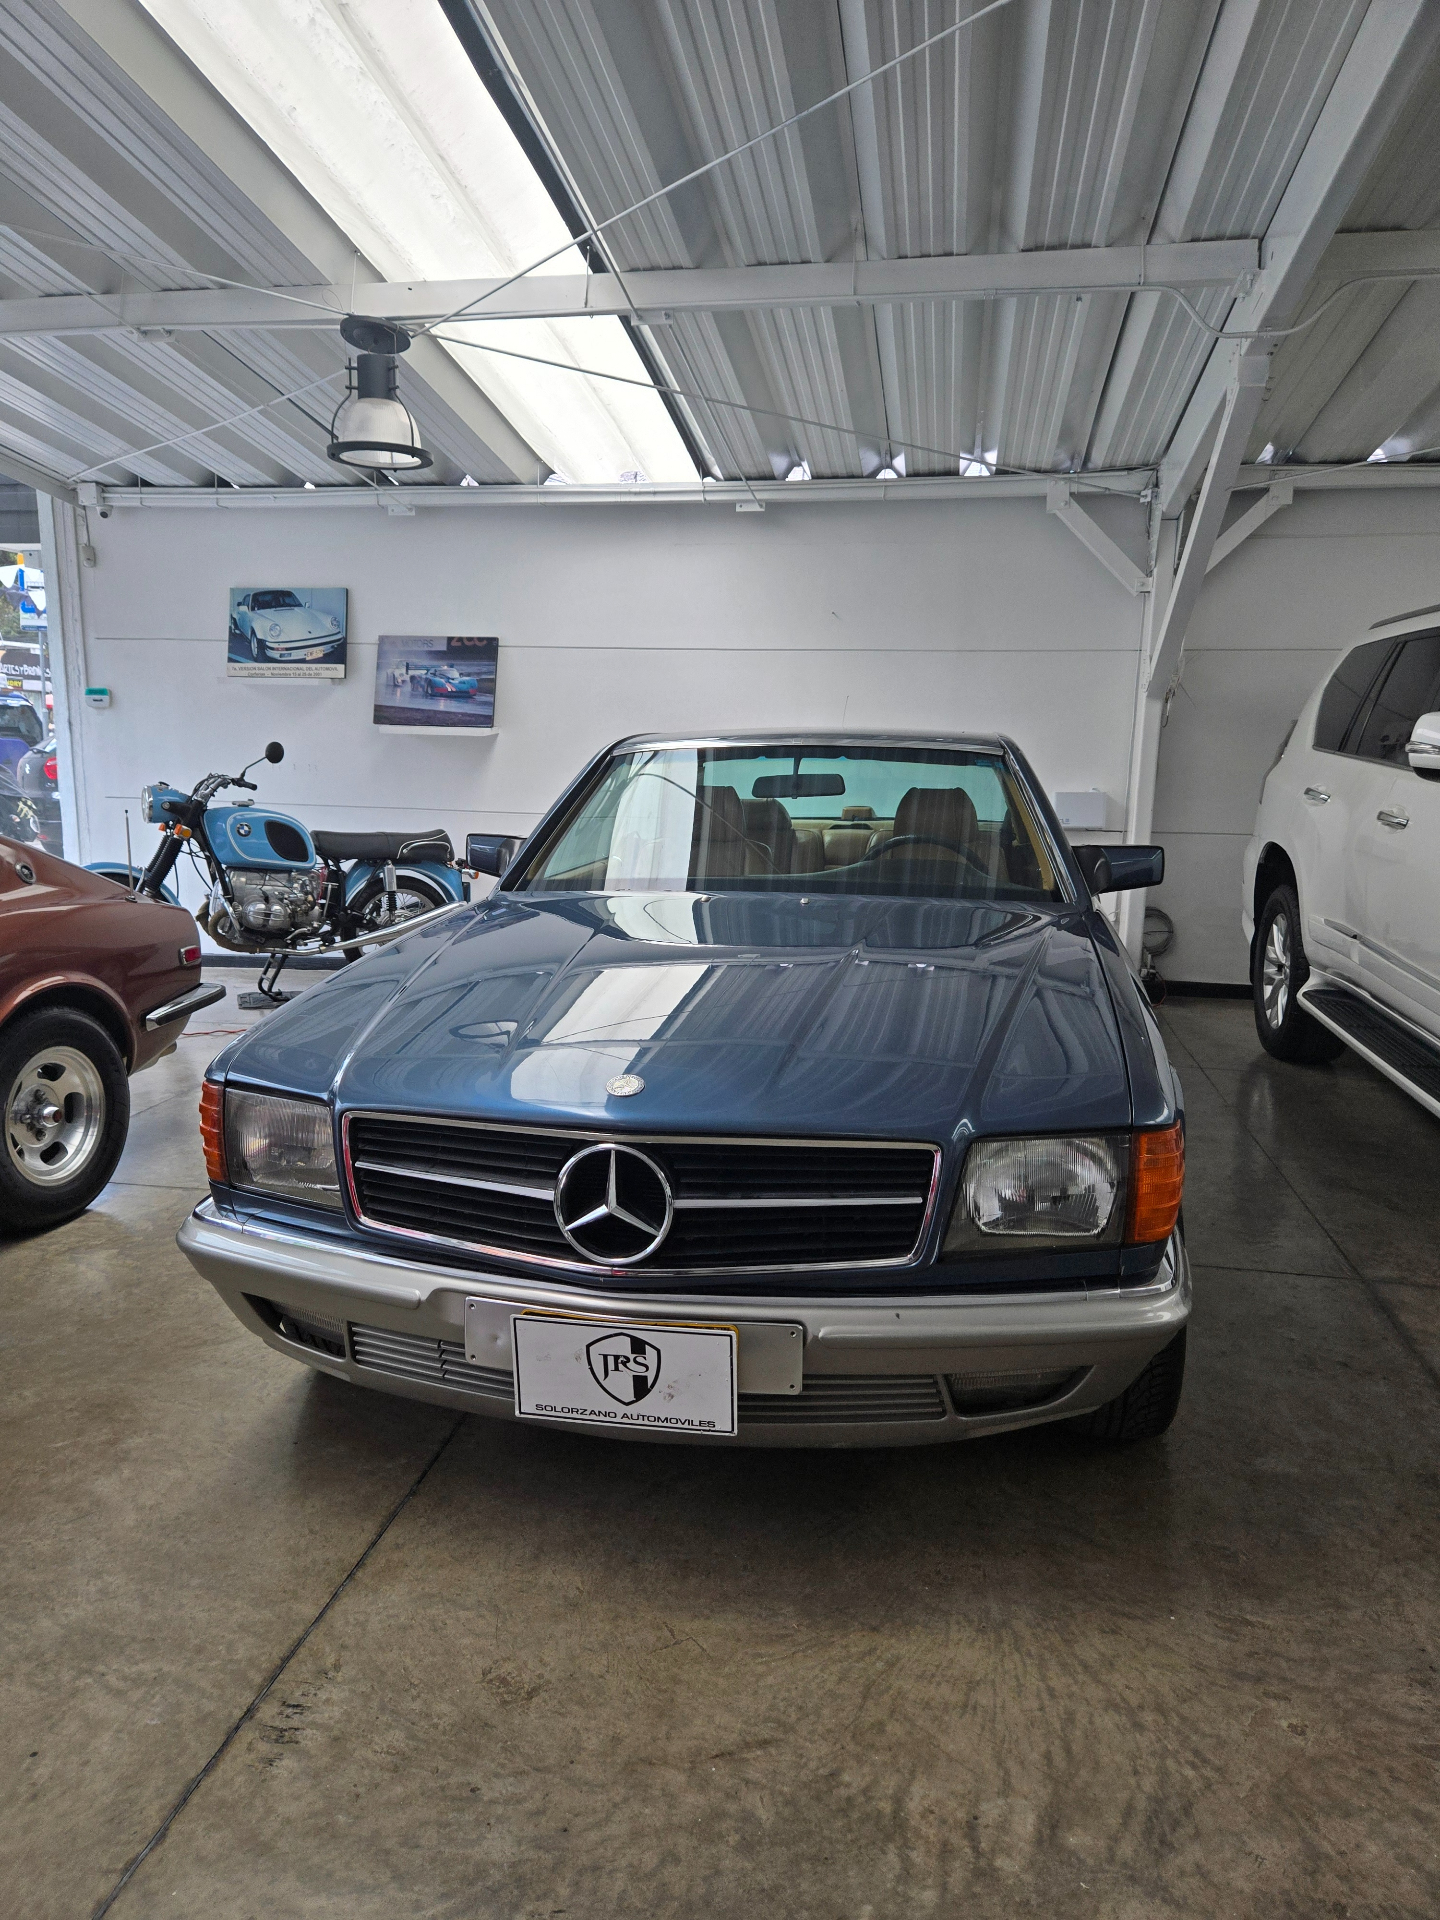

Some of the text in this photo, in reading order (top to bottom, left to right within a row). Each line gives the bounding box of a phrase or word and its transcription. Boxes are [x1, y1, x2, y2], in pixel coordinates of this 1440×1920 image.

[598, 1353, 649, 1381] JRS
[535, 1403, 716, 1428] SOLORZANO AUTOMOVILES
